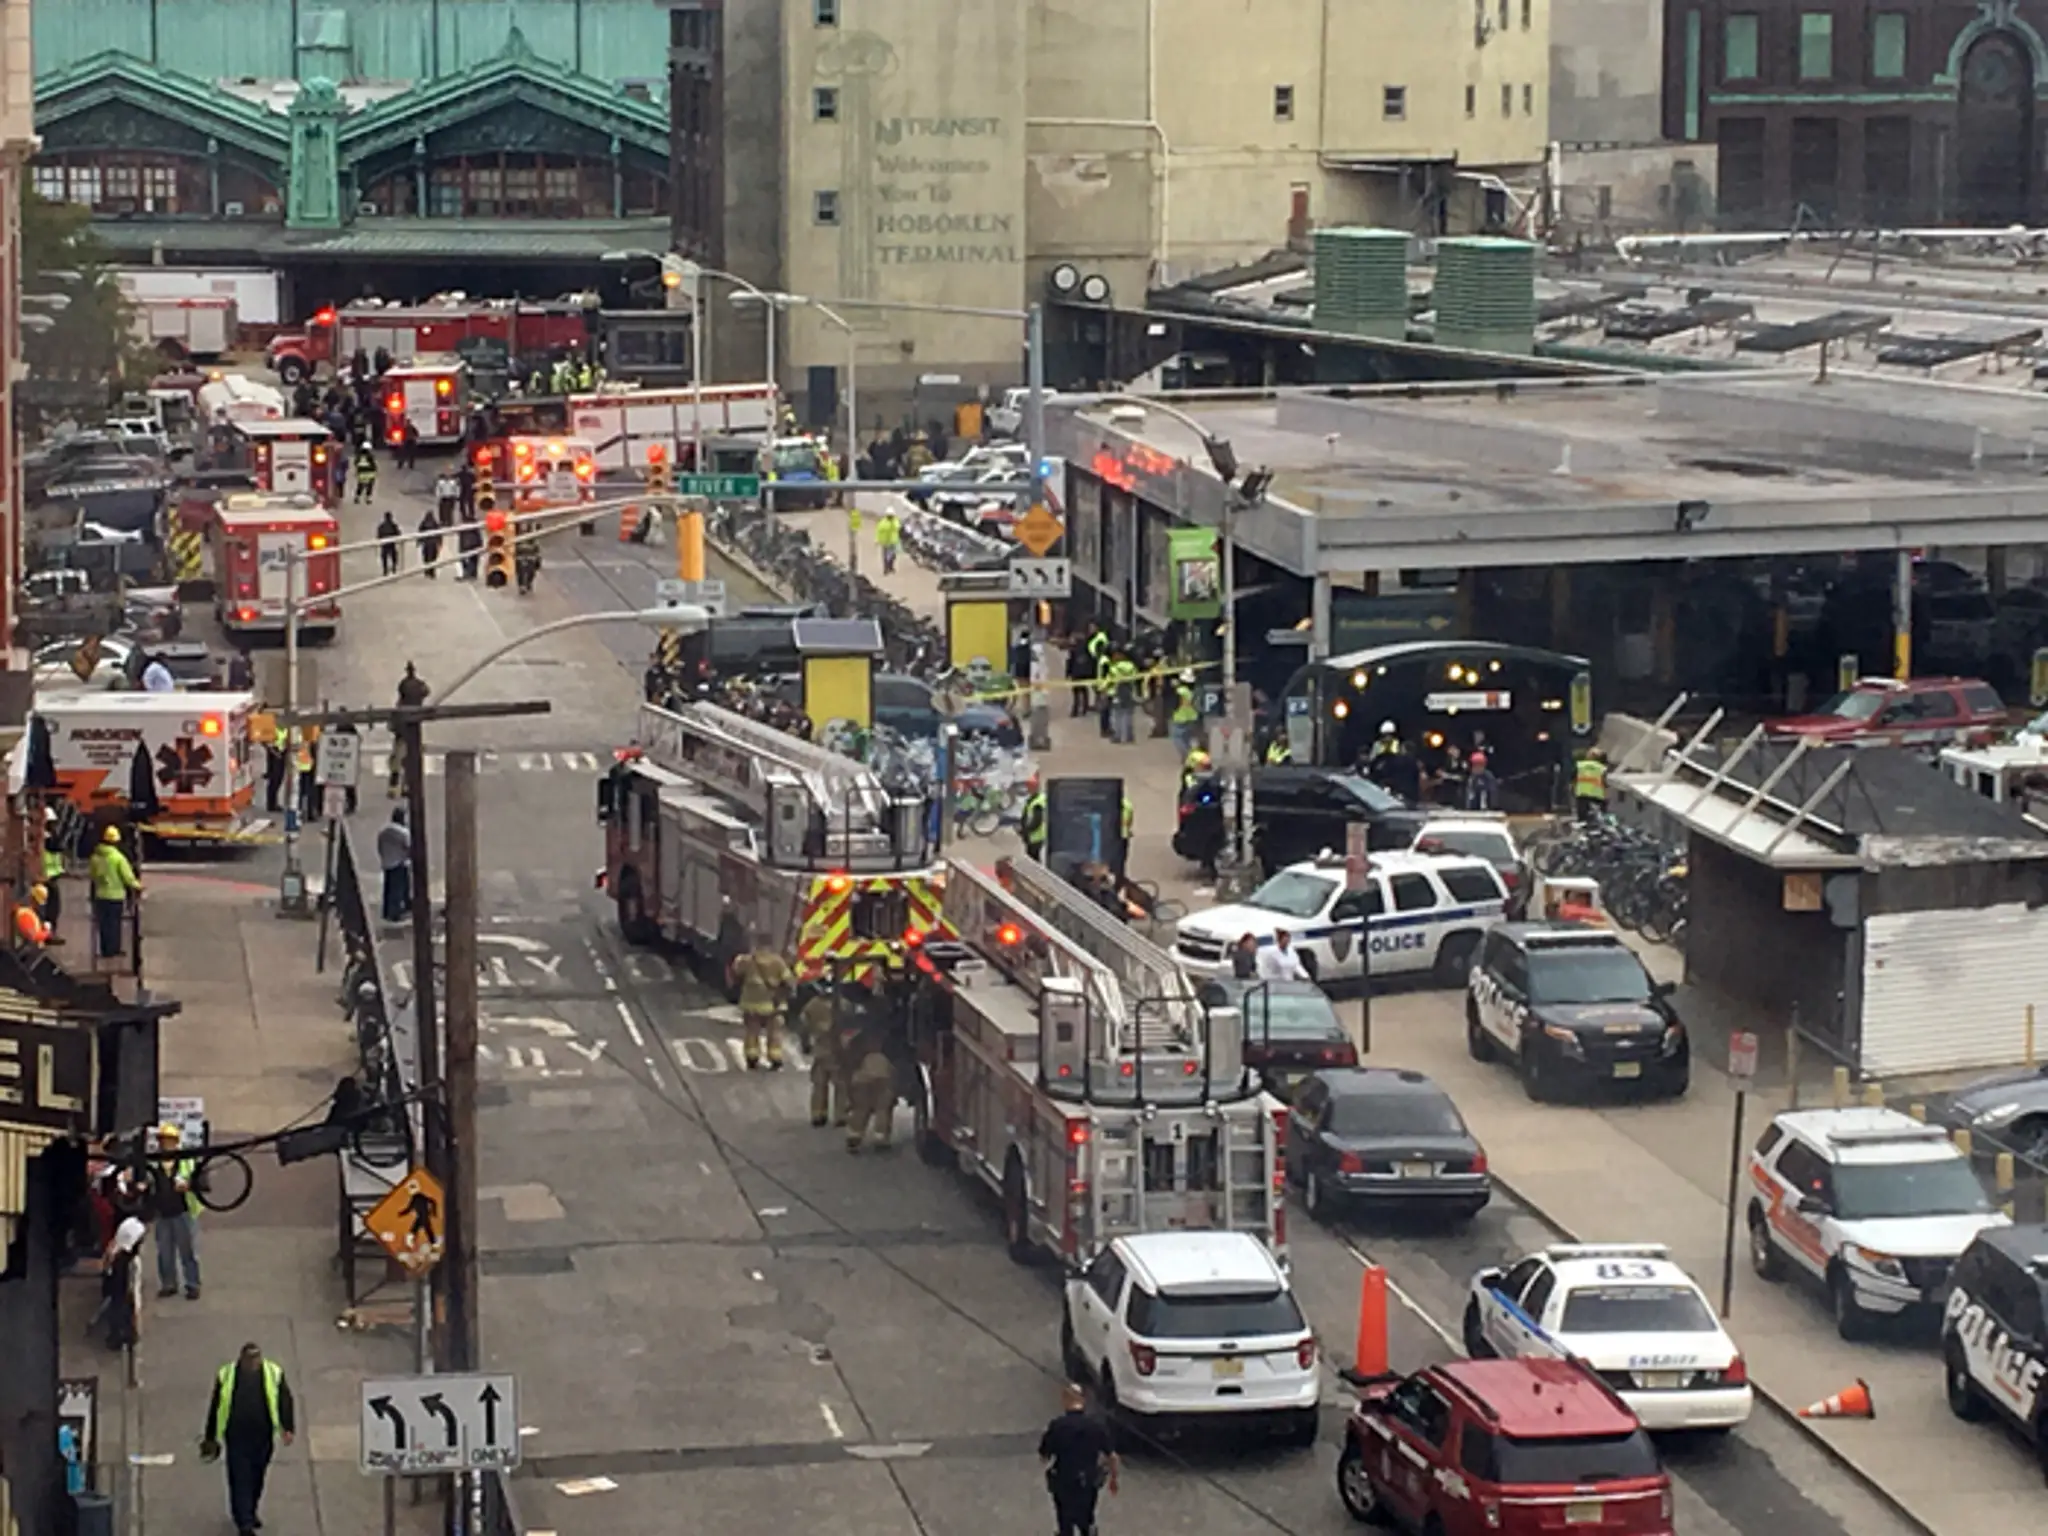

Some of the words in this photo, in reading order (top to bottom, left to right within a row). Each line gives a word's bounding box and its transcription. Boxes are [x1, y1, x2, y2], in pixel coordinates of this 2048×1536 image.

[907, 117, 1001, 137] TRANSIT
[876, 155, 990, 174] Welcomes
[876, 212, 1015, 236] HOBOKEN
[876, 244, 1023, 265] TERMINAL
[688, 478, 734, 493] RIVER
[1205, 693, 1219, 712] P
[1173, 1123, 1183, 1141] 1
[1597, 1263, 1657, 1279] 83
[1941, 1286, 2047, 1396] POLICE
[1628, 1354, 1699, 1369] SHERIFF
